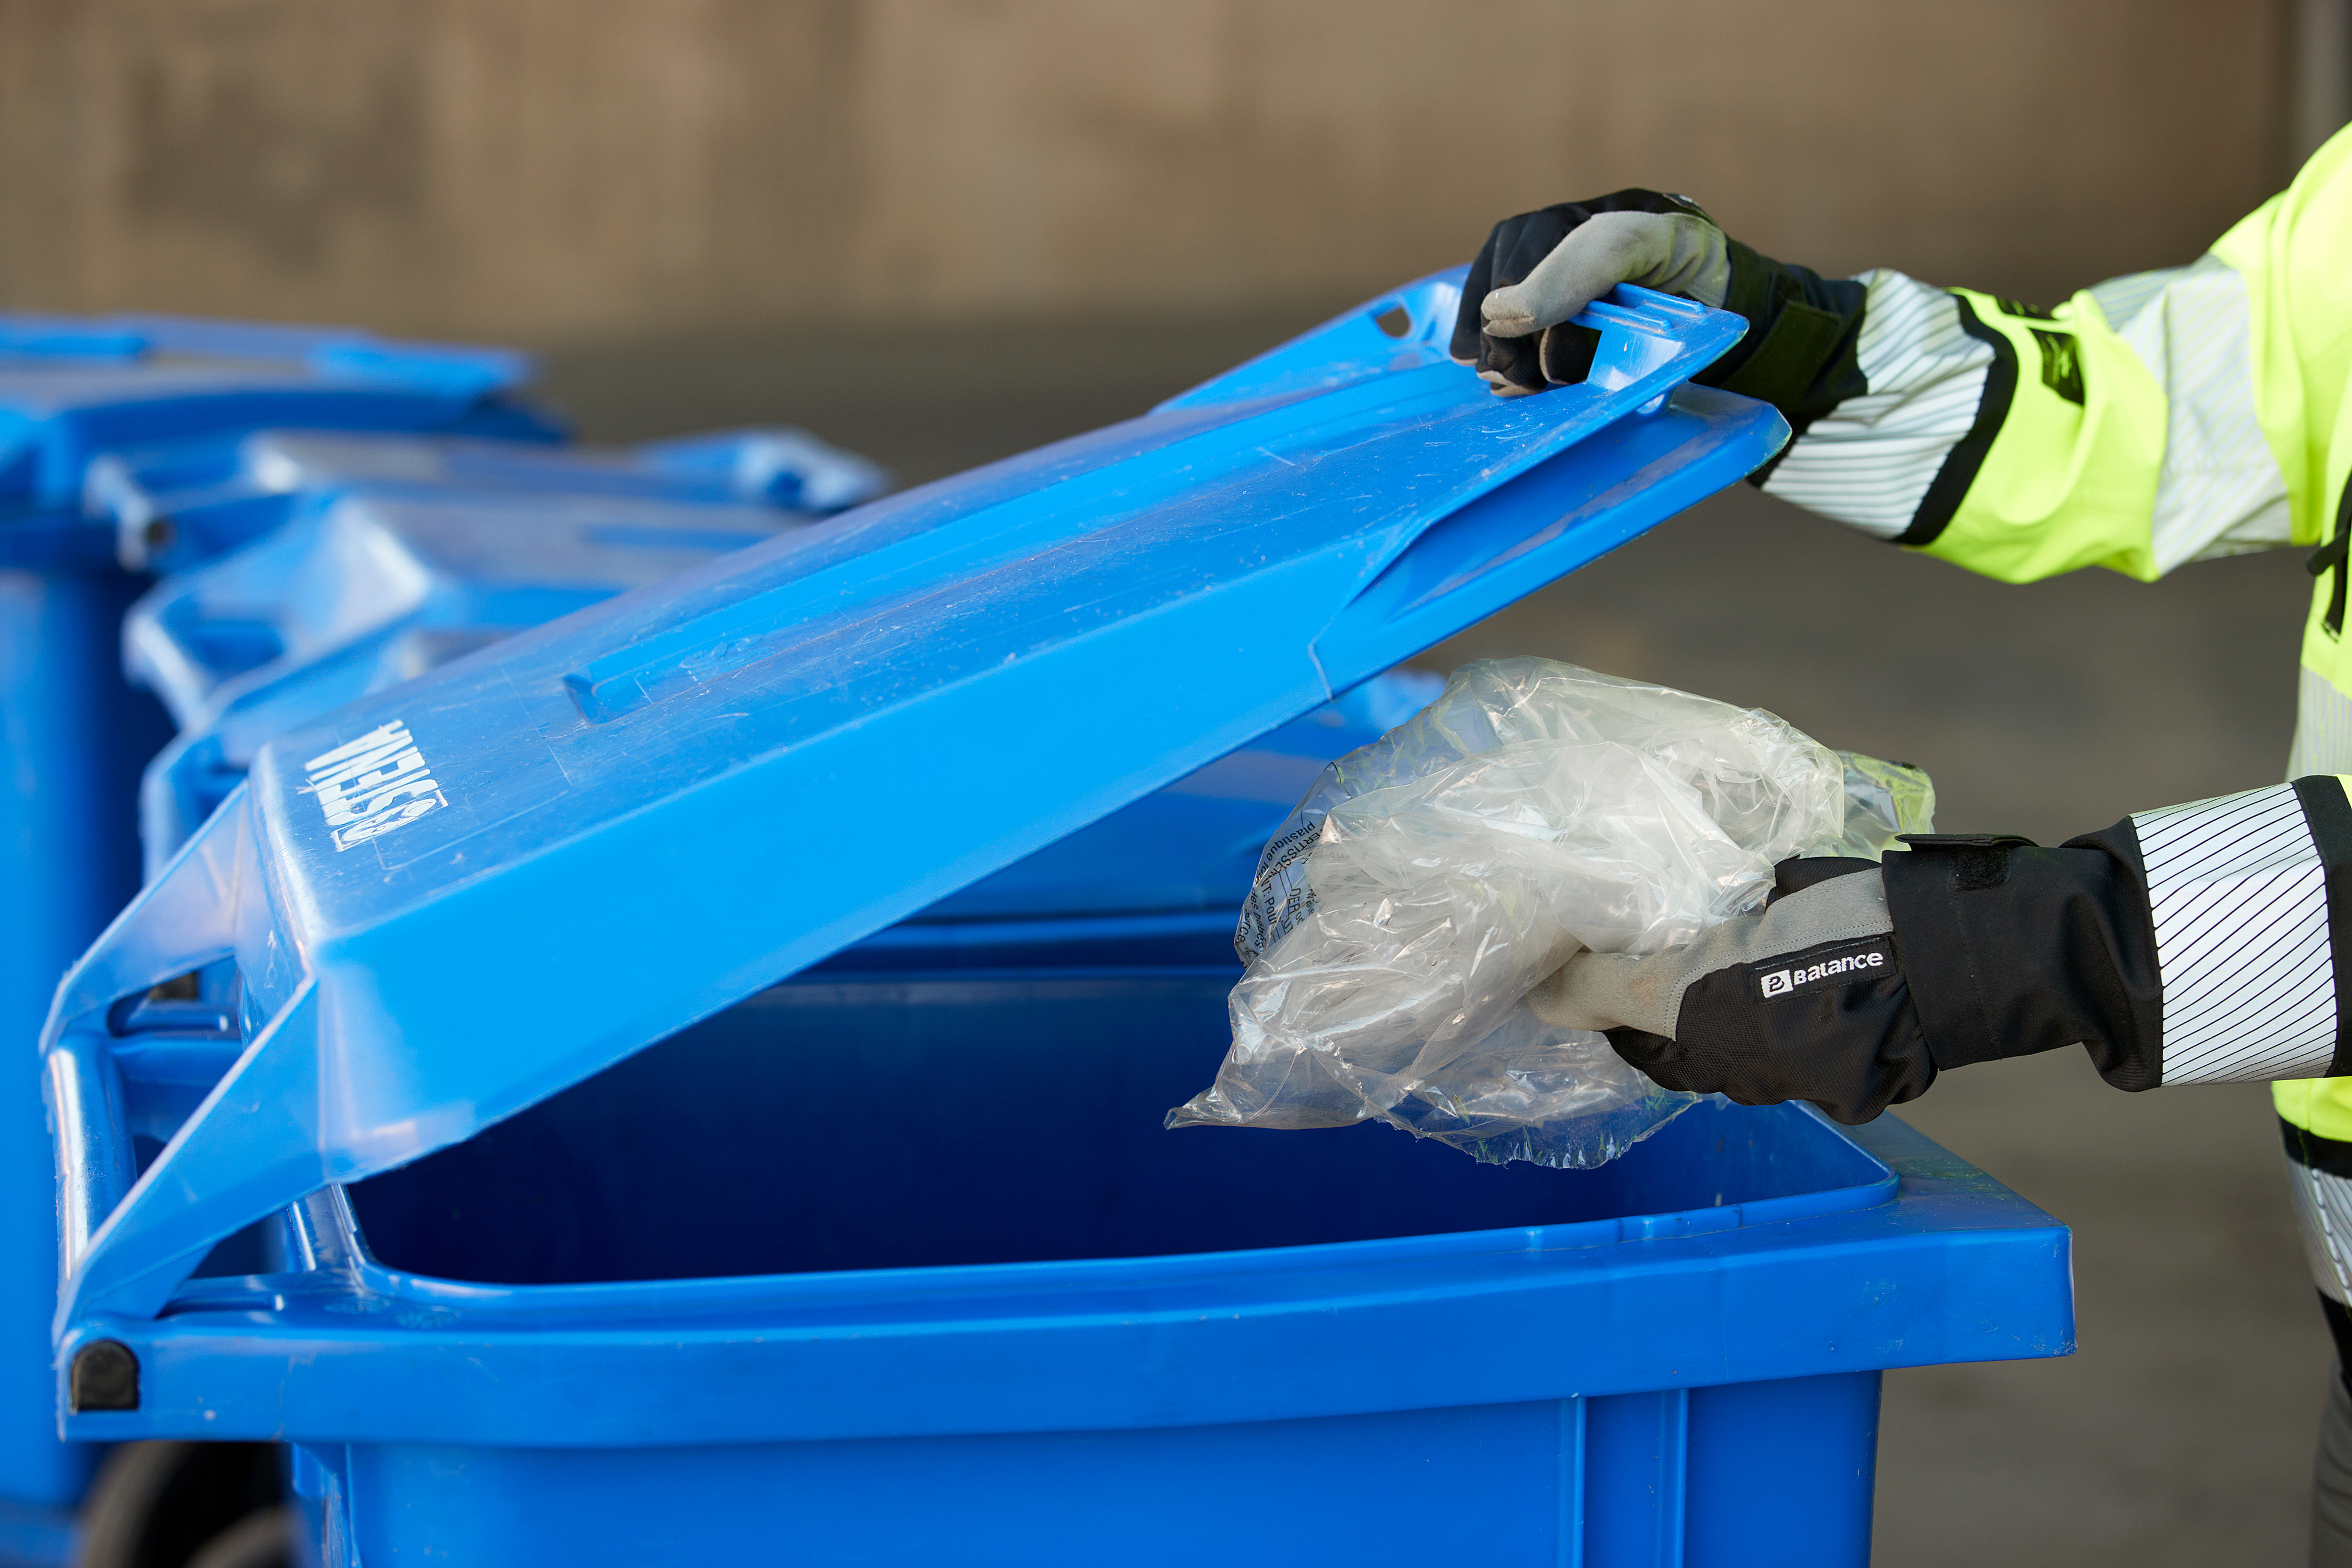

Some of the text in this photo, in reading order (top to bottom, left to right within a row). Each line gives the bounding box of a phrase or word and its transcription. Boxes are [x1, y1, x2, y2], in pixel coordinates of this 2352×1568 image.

[305, 720, 439, 826] STENA
[1267, 821, 1315, 861] plastique
[1793, 952, 1884, 985] Balance
